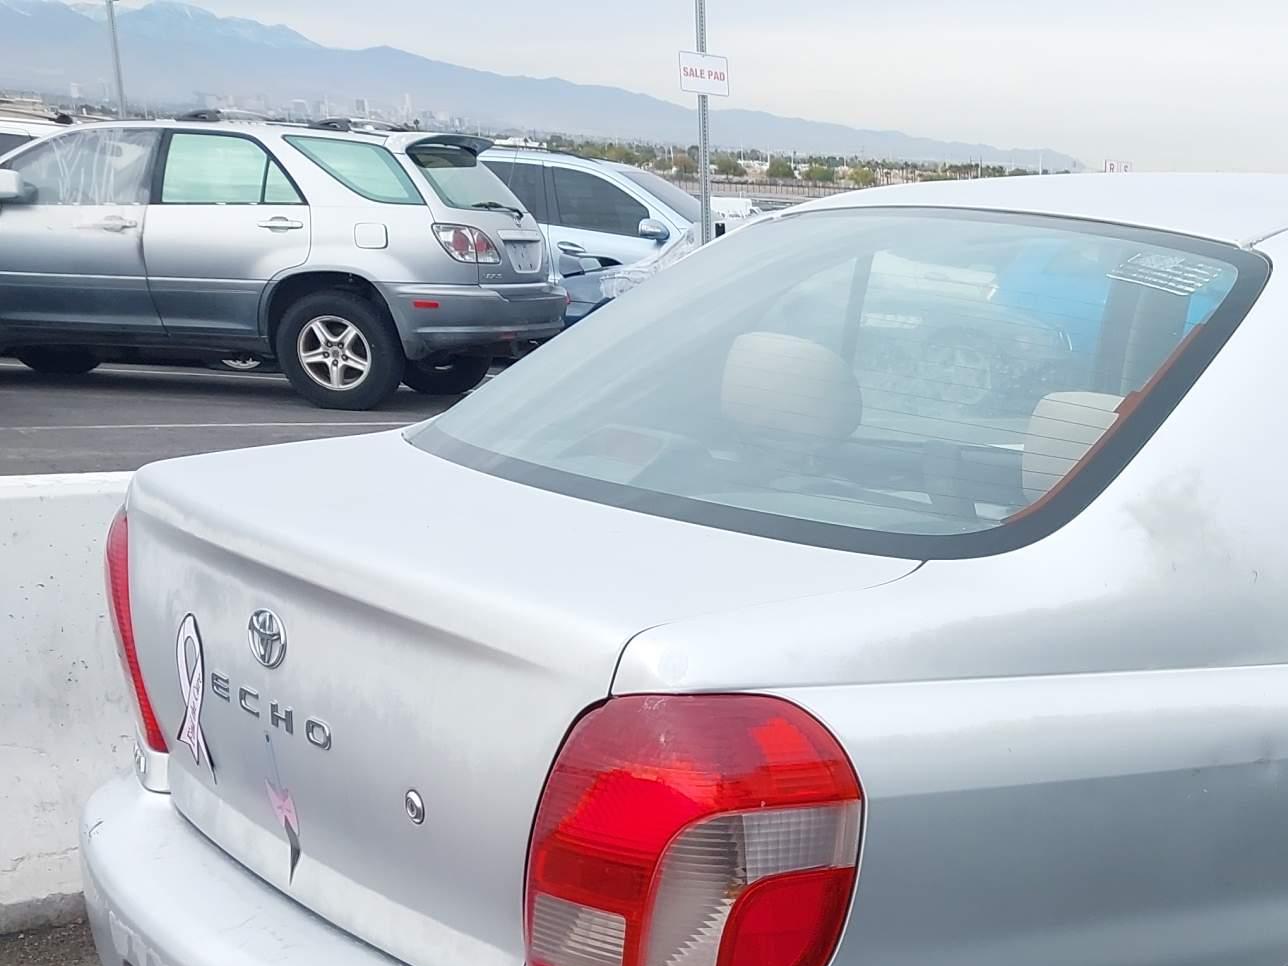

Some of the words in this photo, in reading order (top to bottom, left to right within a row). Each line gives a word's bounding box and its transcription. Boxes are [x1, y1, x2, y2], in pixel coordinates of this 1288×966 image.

[682, 66, 706, 79] SALE
[707, 70, 726, 82] PAD
[210, 671, 332, 752] ECHO
